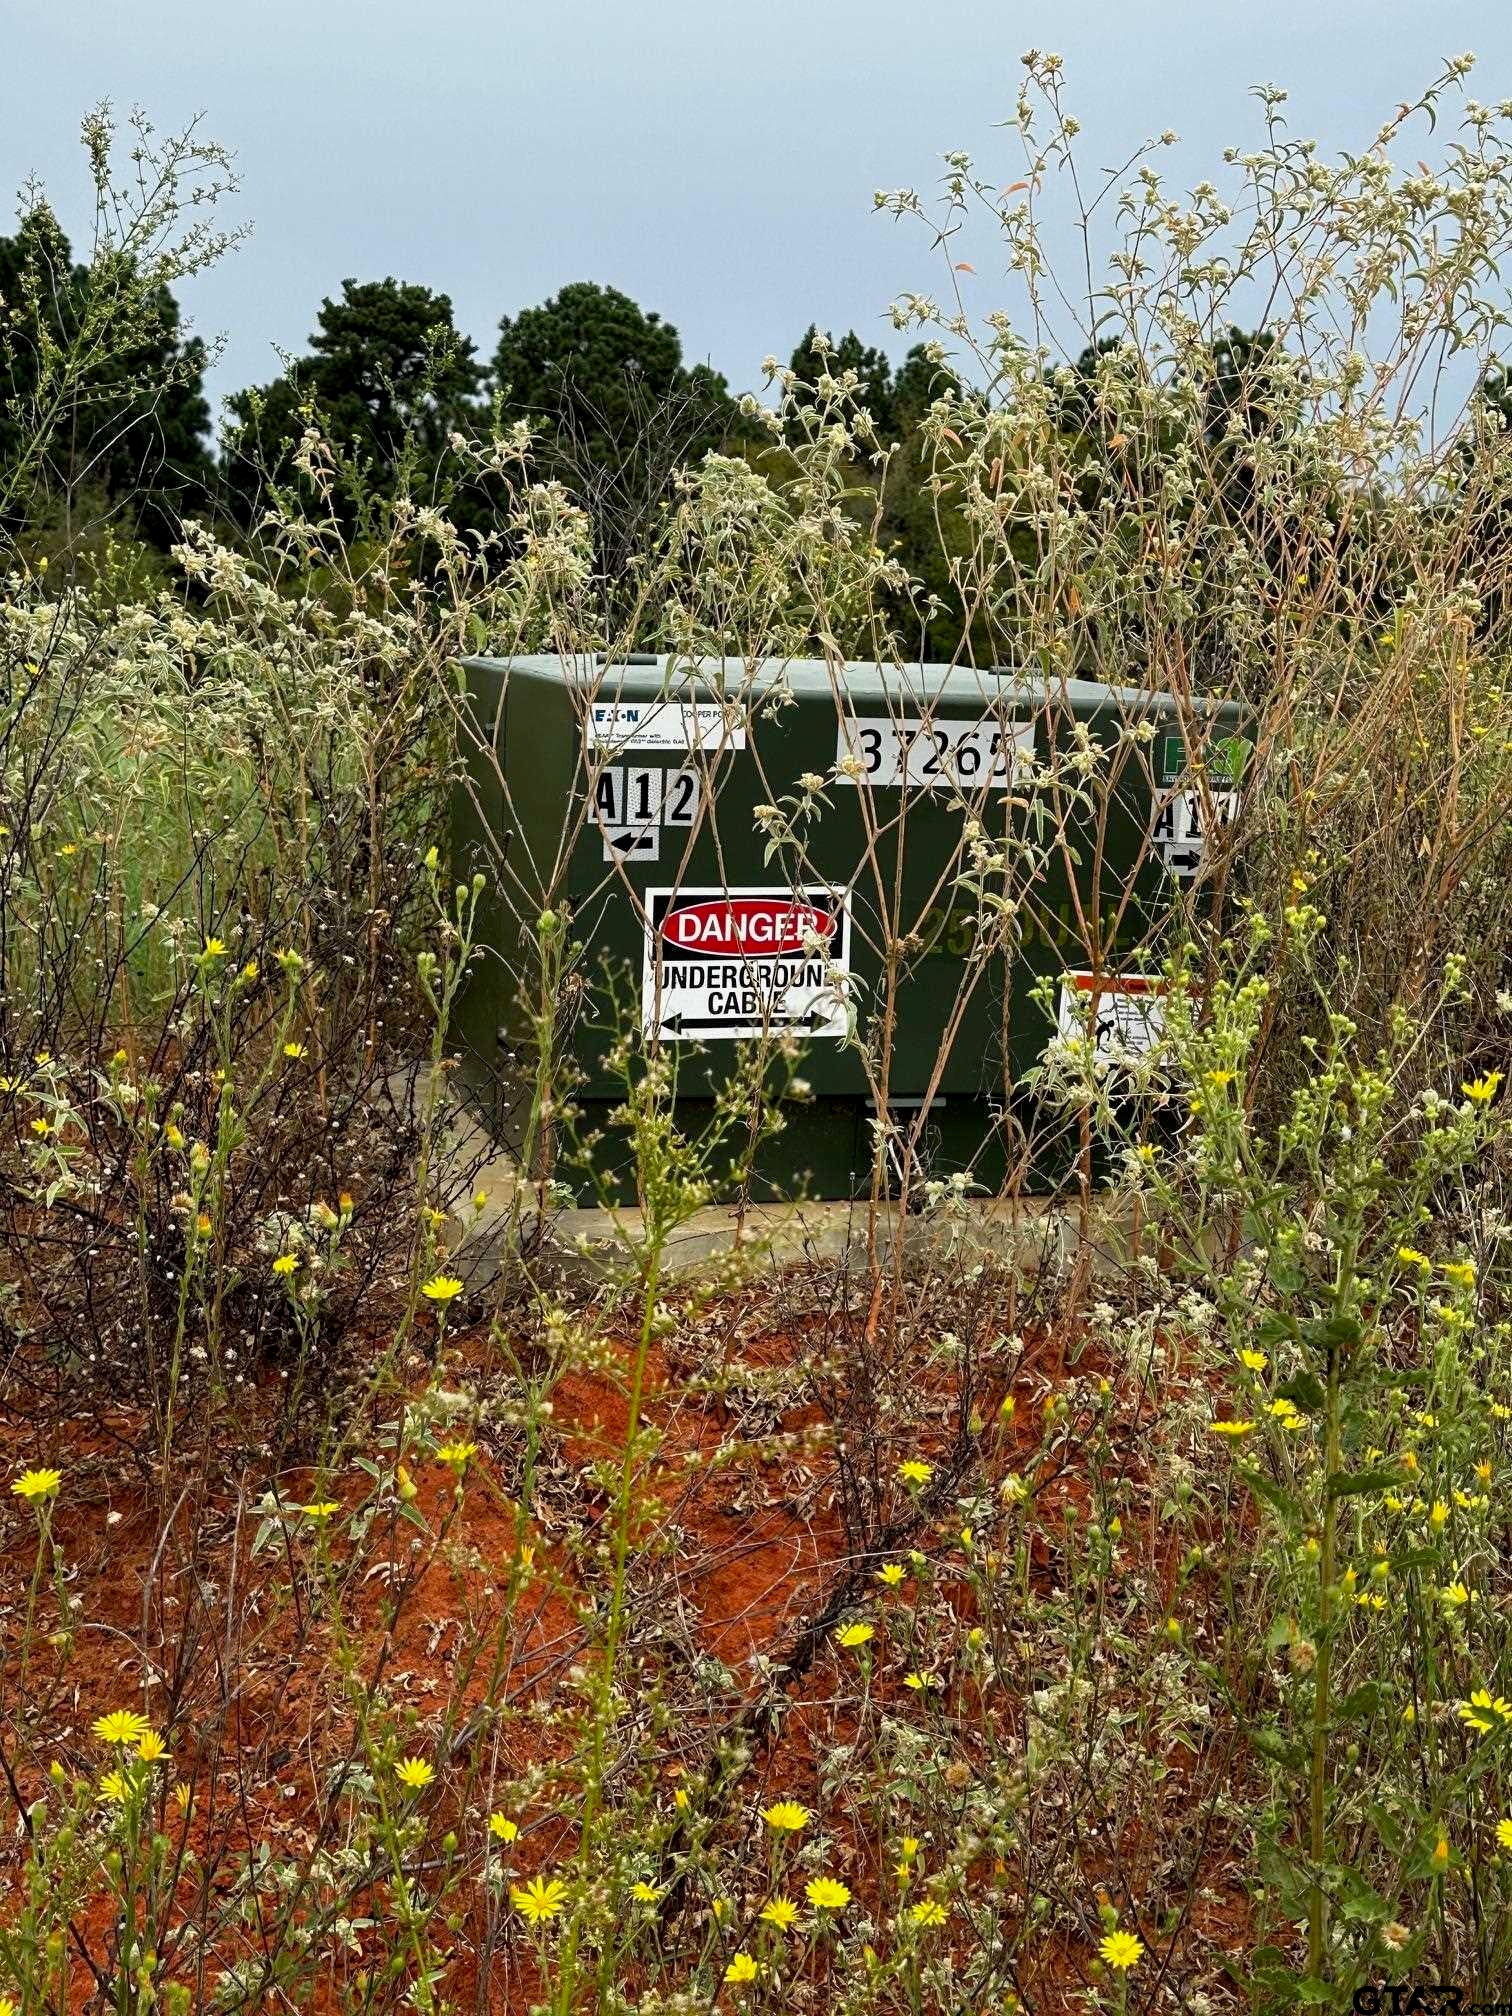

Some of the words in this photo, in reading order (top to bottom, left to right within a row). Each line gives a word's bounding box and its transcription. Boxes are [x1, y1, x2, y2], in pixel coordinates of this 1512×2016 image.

[682, 710, 712, 718] COPER
[678, 912, 820, 943] DANGER
[660, 964, 836, 989] UNDERGROUN
